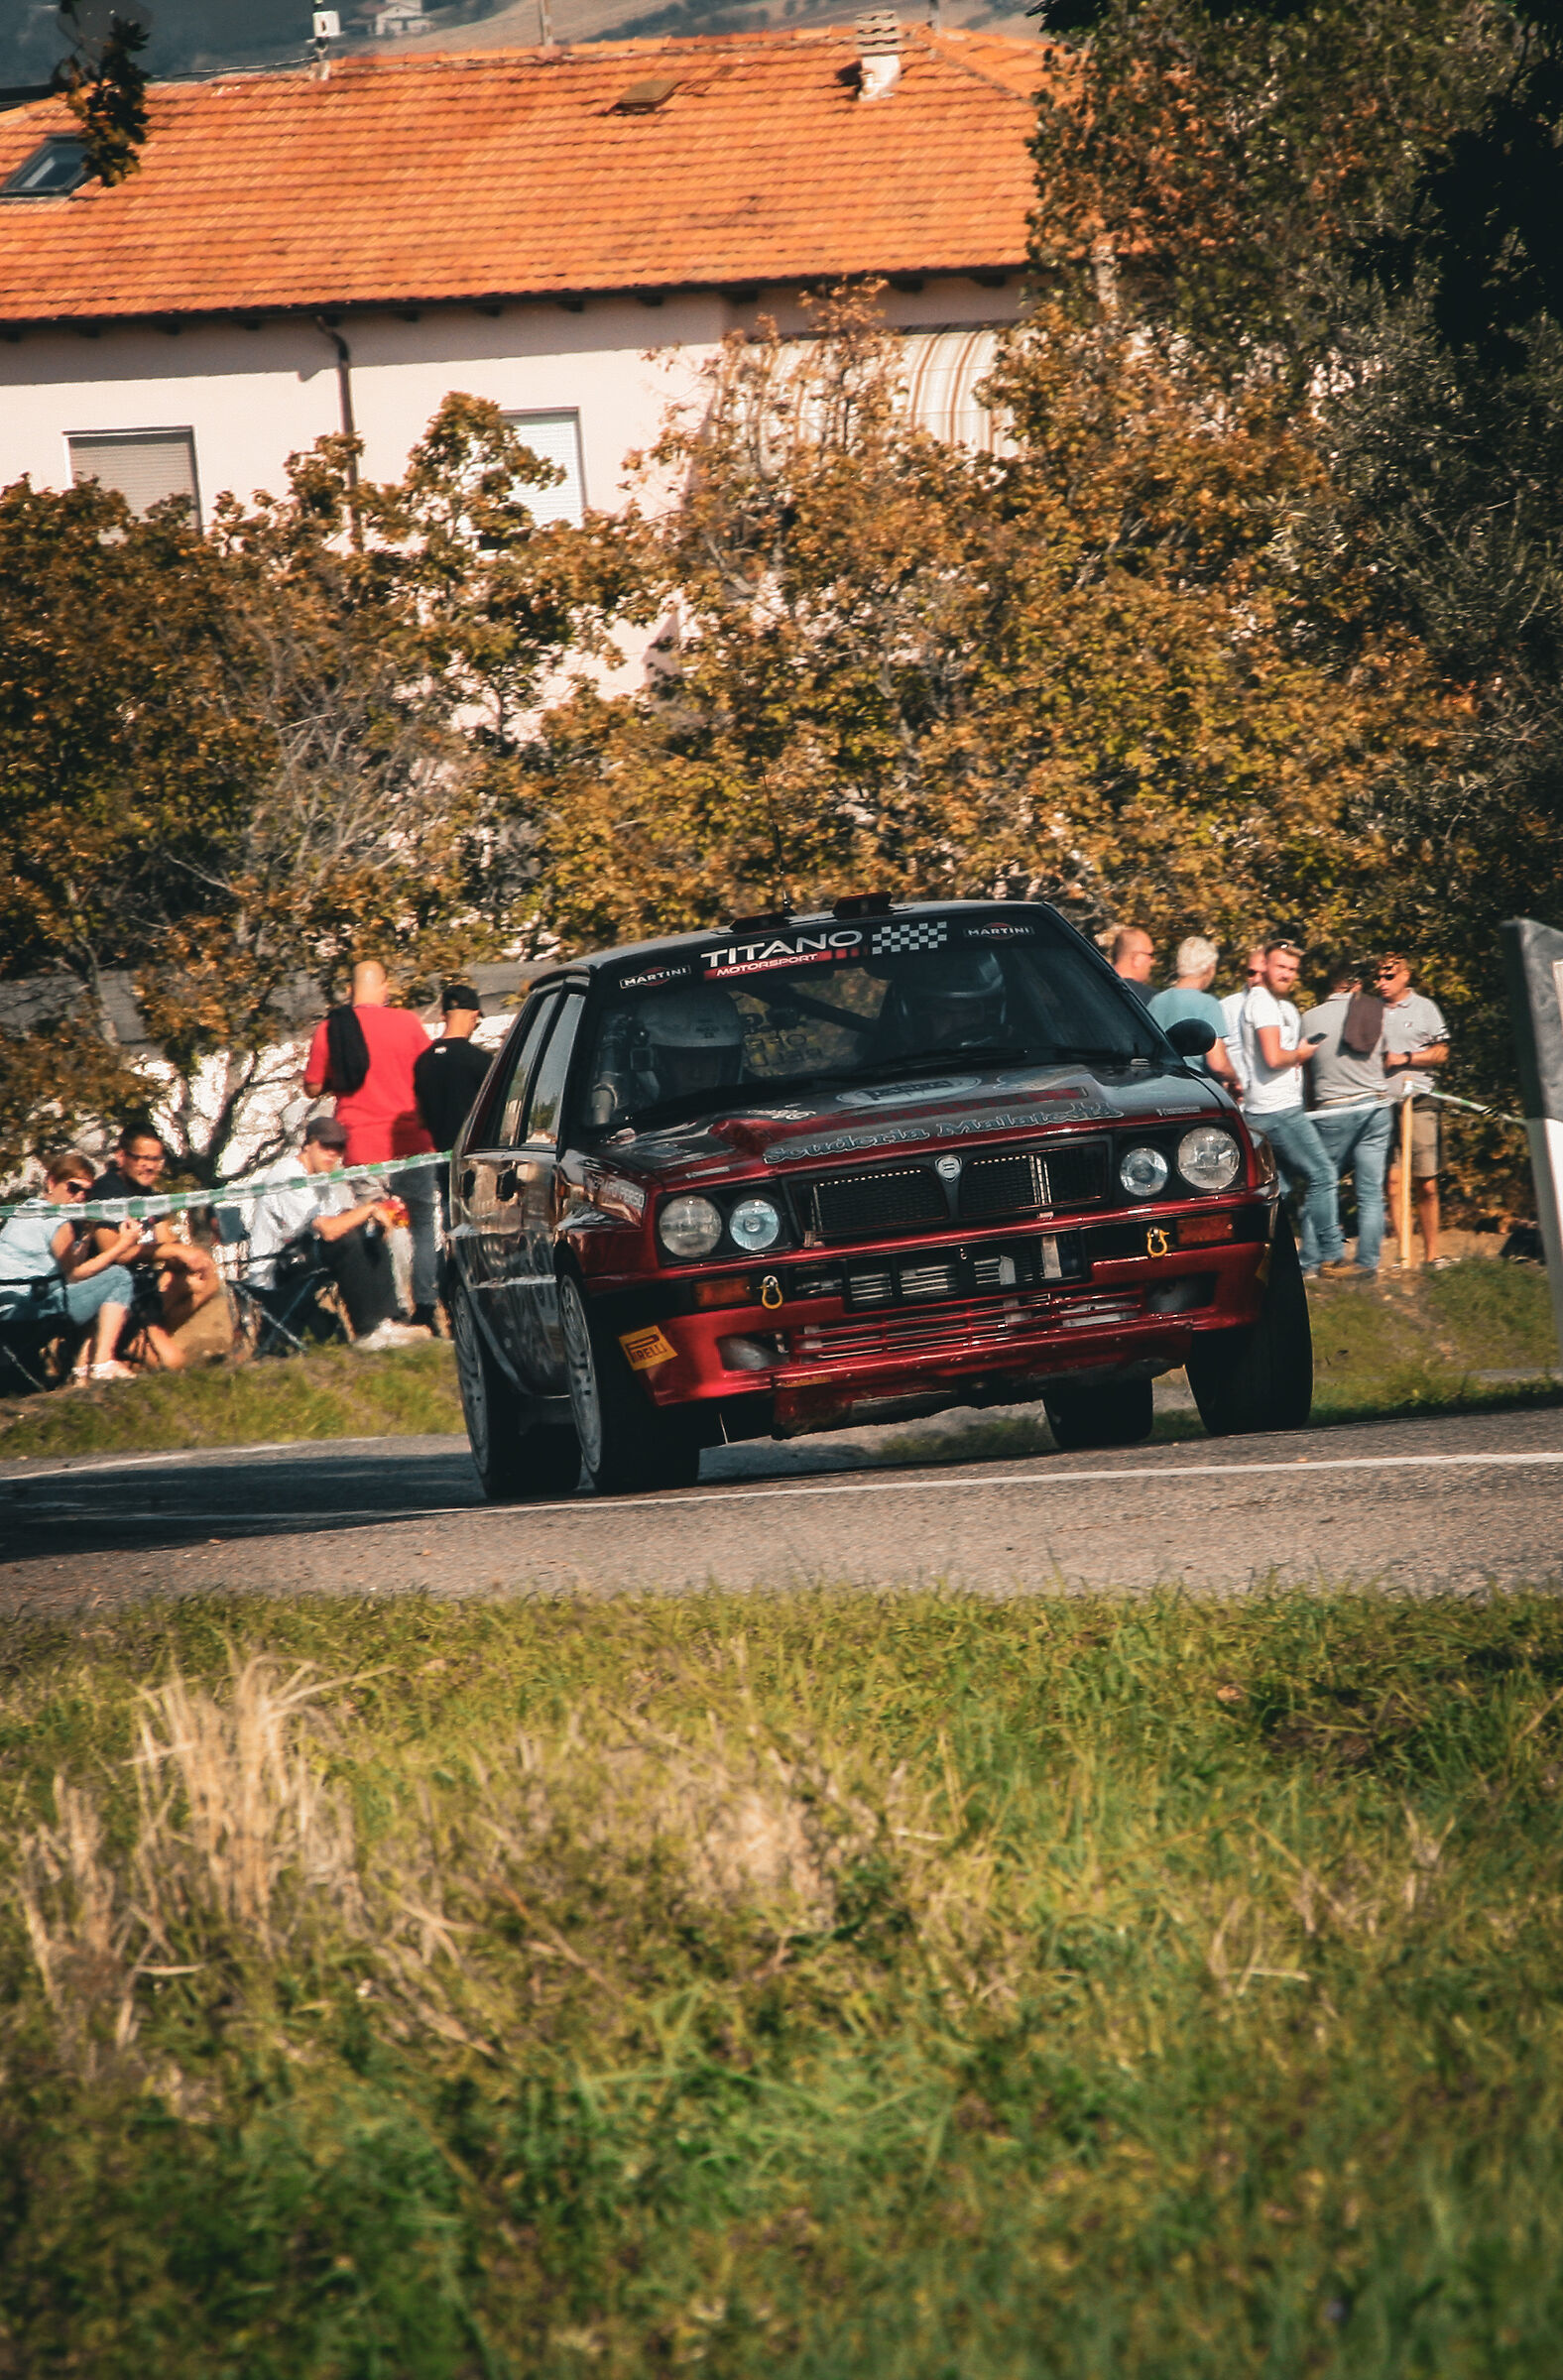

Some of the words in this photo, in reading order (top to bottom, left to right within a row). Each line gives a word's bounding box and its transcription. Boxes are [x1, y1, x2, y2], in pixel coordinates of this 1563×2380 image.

[968, 926, 1030, 937] MARTINI
[700, 929, 864, 968] TITANO
[716, 953, 818, 977] MOTORSPORT
[624, 966, 687, 988] MARTINI
